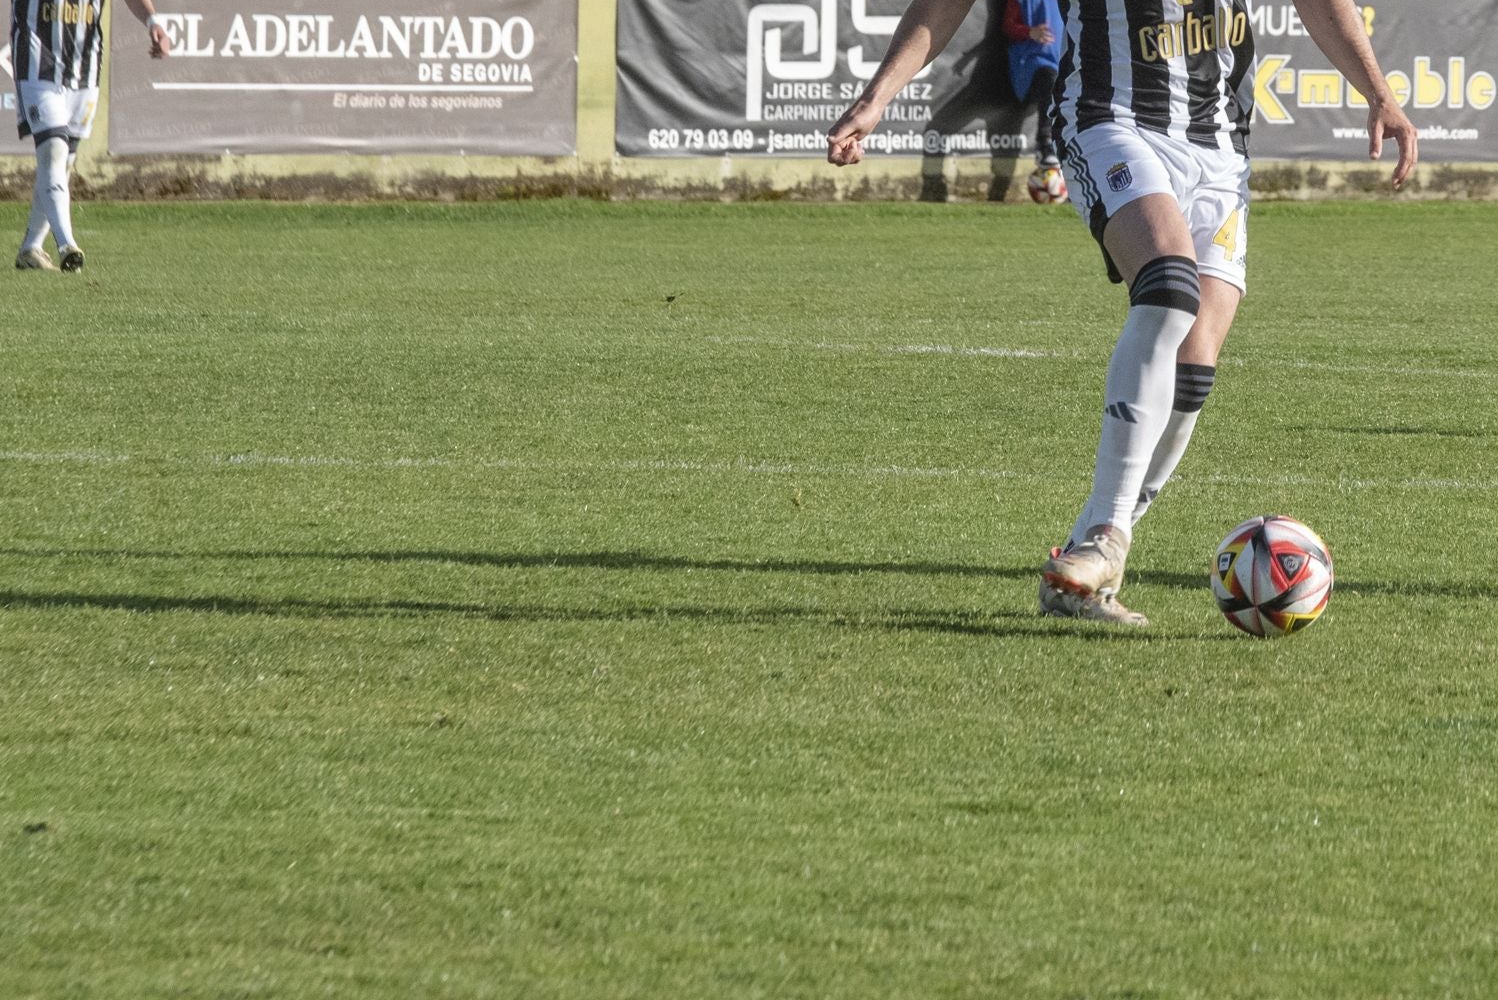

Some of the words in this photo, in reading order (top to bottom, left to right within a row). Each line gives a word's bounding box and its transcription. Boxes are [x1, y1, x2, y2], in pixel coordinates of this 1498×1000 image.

[163, 13, 214, 58] EL
[220, 14, 535, 60] ADELANTADO
[1139, 9, 1246, 62] carballo
[418, 64, 443, 82] DE
[450, 63, 534, 82] SEGOVIA
[766, 83, 833, 99] JORGE
[840, 79, 933, 99] SÁHEZ
[333, 93, 347, 108] El
[350, 93, 386, 108] diario
[389, 94, 405, 108] de
[408, 94, 427, 108] los
[430, 95, 502, 111] segovianos
[764, 103, 850, 121] CARPINTERÍ
[880, 103, 932, 121] TÁLICA
[648, 129, 678, 150] 620
[683, 129, 706, 150] 79
[708, 129, 729, 150] 03
[733, 129, 754, 150] 09
[767, 128, 1028, 153] jsanchrrajeria@gmail.com
